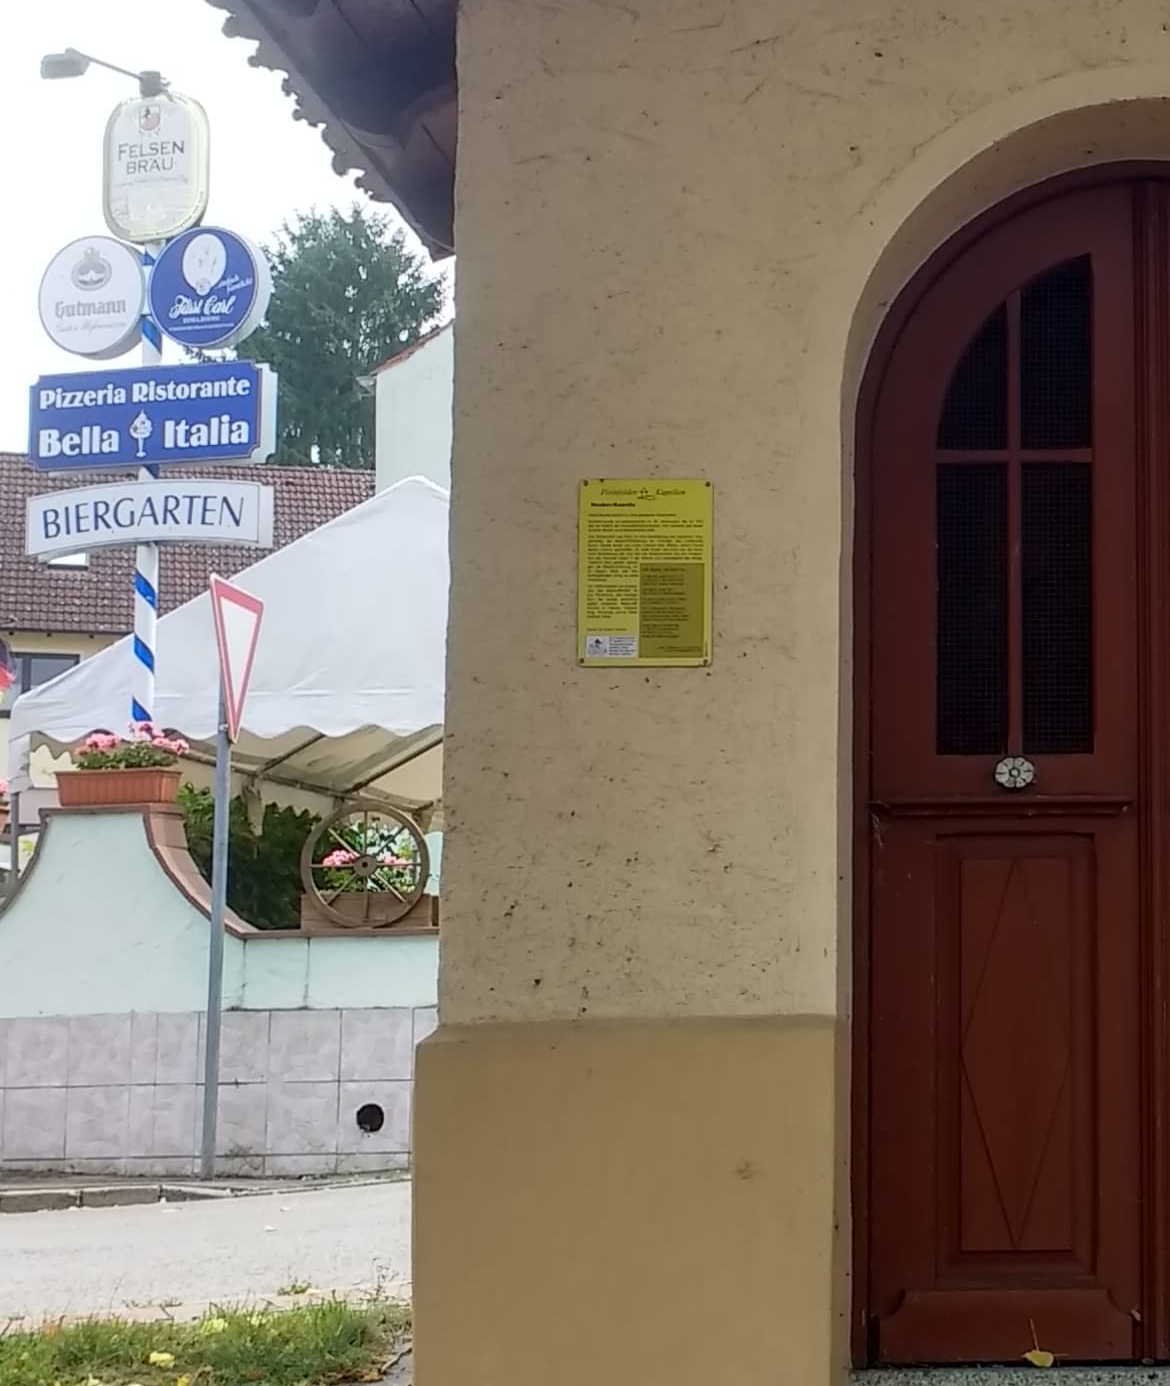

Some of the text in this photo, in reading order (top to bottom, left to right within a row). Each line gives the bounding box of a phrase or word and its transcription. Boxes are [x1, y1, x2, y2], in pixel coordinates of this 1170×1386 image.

[117, 140, 185, 161] FELSEN
[55, 298, 127, 319] Gutmann
[203, 294, 237, 315] Carl
[39, 376, 251, 410] Pizzeria Ristorante
[38, 414, 250, 458] Bella Italia
[42, 495, 245, 539] BIERGARTEN
